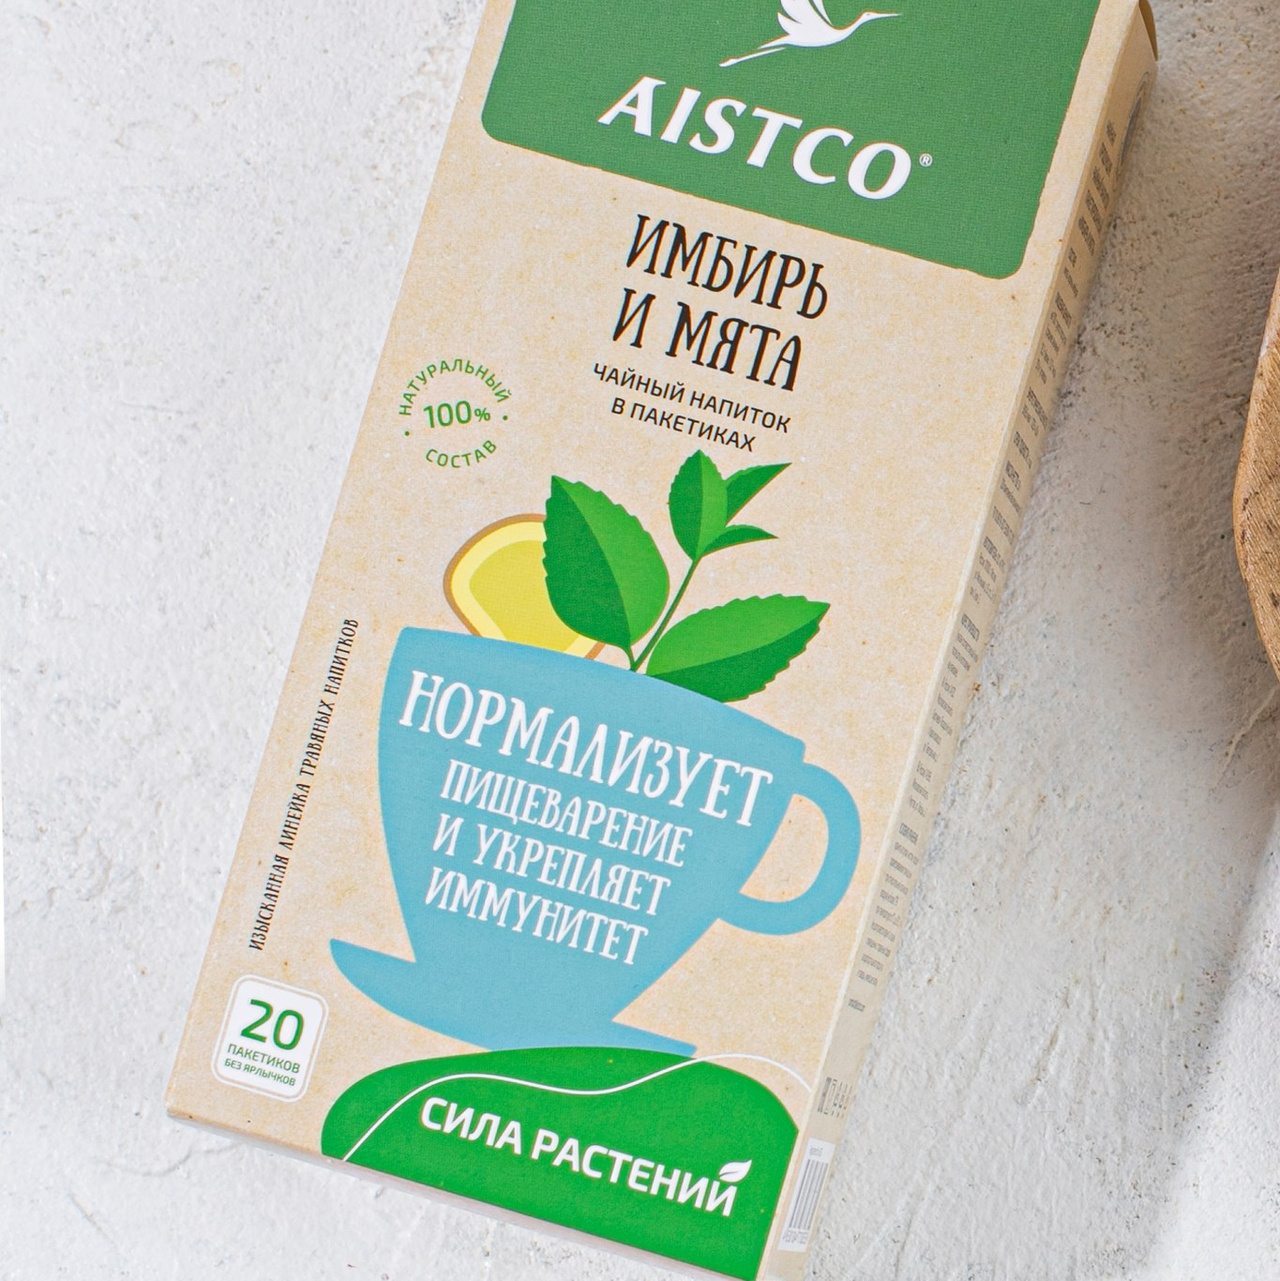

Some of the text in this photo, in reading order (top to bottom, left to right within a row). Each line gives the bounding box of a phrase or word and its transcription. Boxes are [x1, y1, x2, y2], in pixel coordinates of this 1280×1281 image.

[625, 213, 829, 320] ИМБИРЬ
[611, 287, 803, 392] И МЯТА
[398, 358, 512, 416] НАТУРАЛЬНЫЙ
[422, 399, 492, 429] 100%
[592, 361, 792, 434] ЧАЙНЫЙ НАПИТОК
[424, 439, 497, 468] СОСТАВ
[610, 396, 757, 452] В ПАКЕТИКАХ
[398, 670, 774, 828] НОРМАЛИЗУЕТ
[248, 617, 360, 951] ИЗЫСКАННАЯ ЛИНЕЙКА ТРАВЯНЫХ НАПИТКОВ
[439, 758, 694, 868] ПИЩЕВАРЕНИЕ
[431, 812, 672, 917] И УКРЕПЛЯЕТ
[424, 865, 649, 966] ИММУНИТЕТ
[239, 998, 305, 1051] 20
[224, 1057, 297, 1087] БЕЗ ЯРЛЫЧКОВ
[226, 1043, 301, 1075] ПАКЕТИКОВ
[419, 1096, 523, 1156] СИЛА
